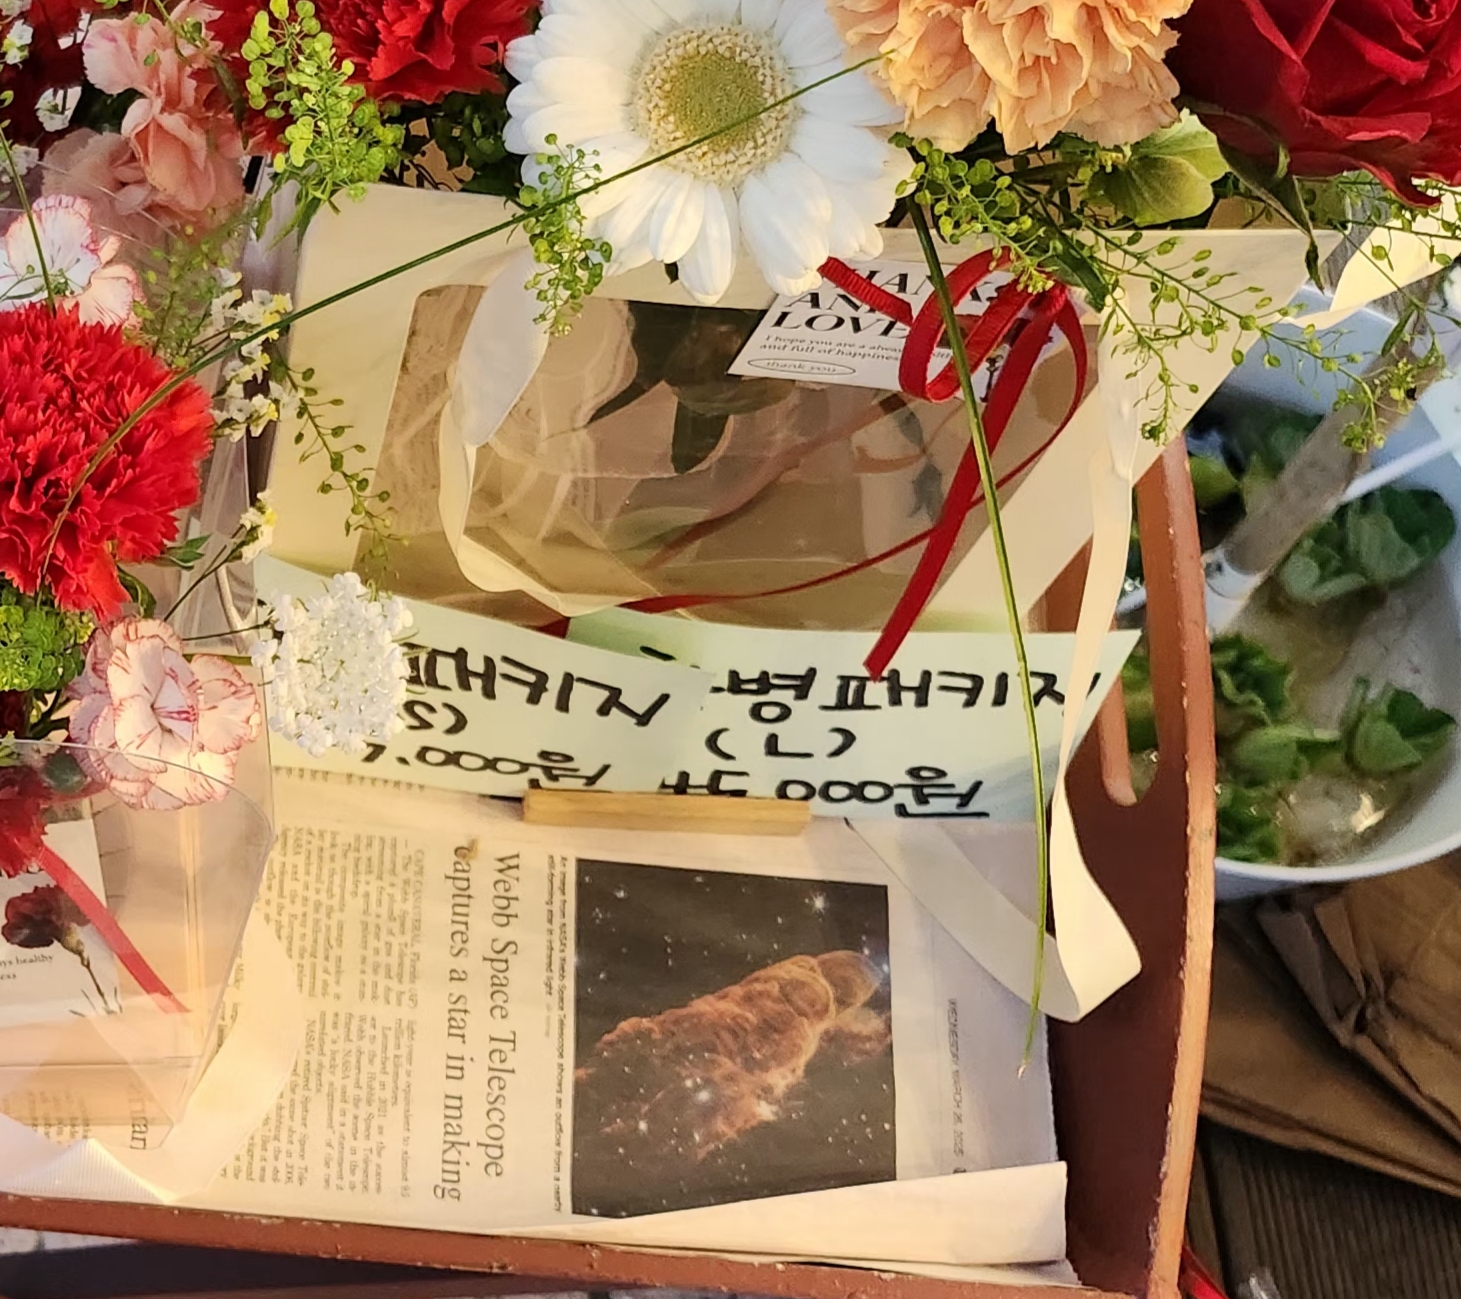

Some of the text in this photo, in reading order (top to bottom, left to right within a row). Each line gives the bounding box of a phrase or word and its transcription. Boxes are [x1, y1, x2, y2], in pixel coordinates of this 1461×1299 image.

[786, 292, 882, 313] AN
[16, 954, 54, 966] healthy
[448, 969, 468, 983] a
[446, 989, 471, 1045] star
[476, 851, 521, 1178] Webb Space Telescope
[445, 1052, 475, 1081] in
[433, 1093, 471, 1203] making
